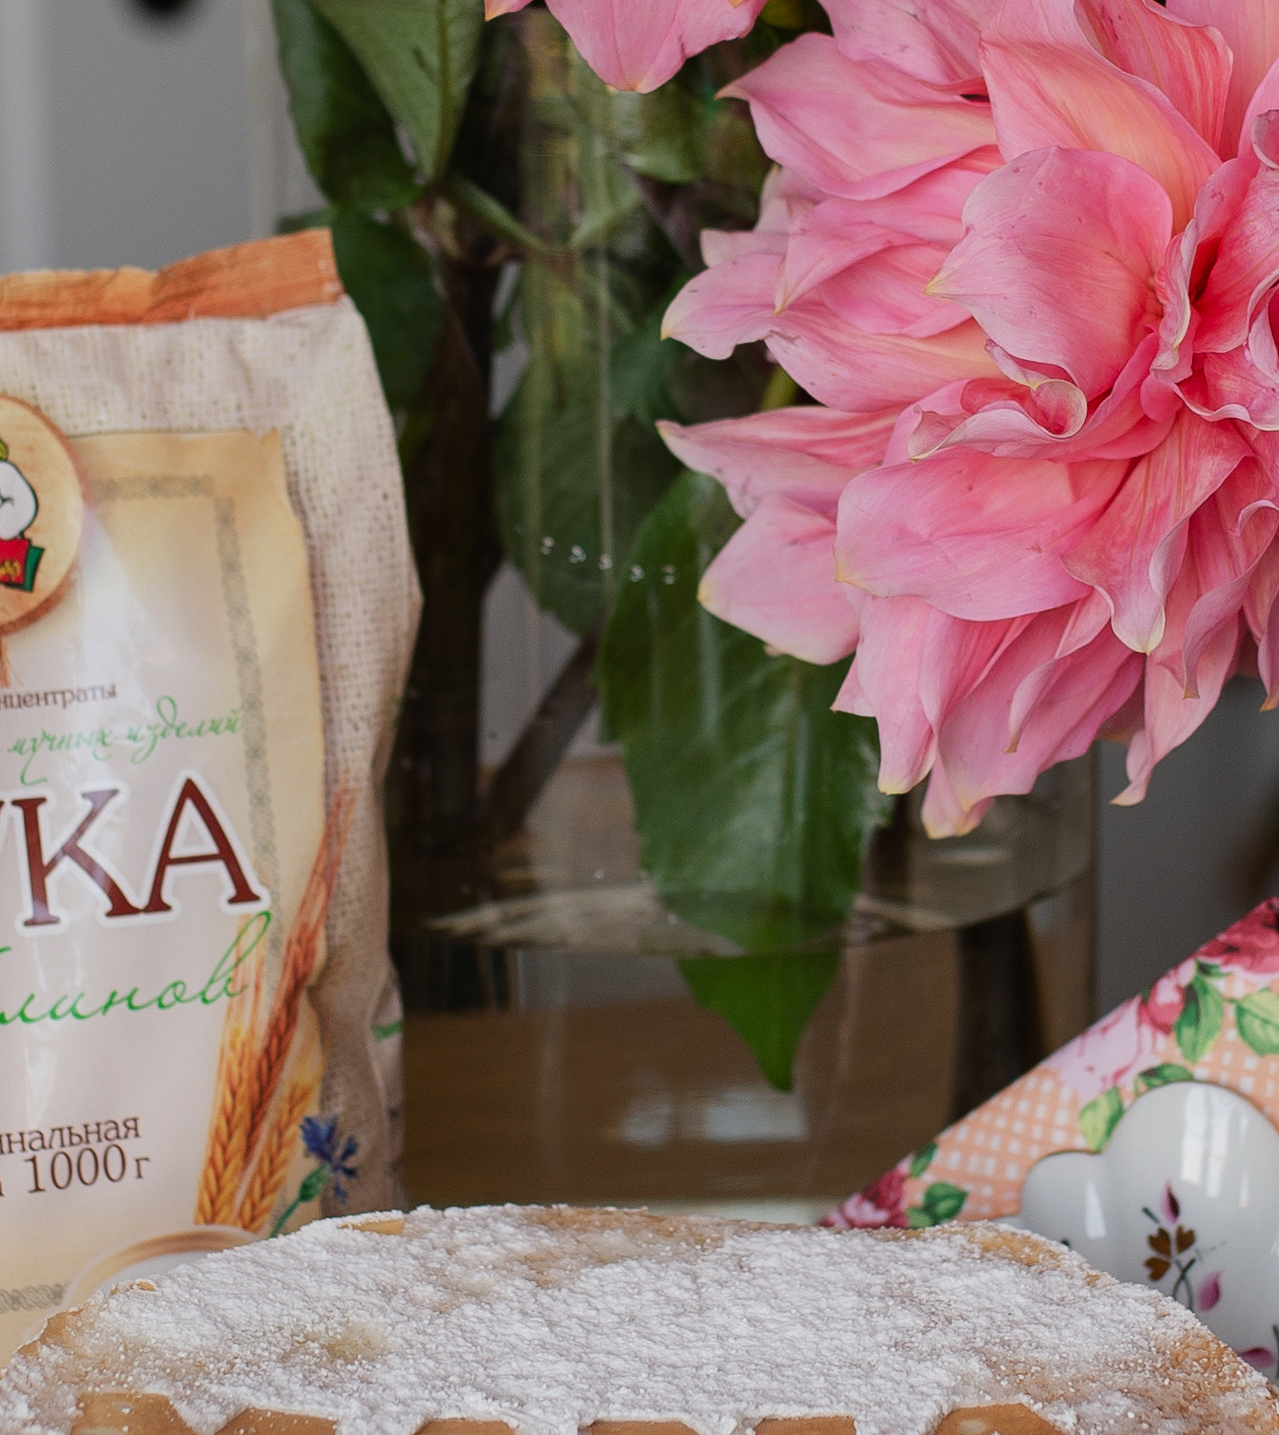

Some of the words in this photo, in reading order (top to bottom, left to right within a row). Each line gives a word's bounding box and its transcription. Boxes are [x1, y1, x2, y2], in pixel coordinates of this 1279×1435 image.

[8, 727, 119, 785] мучных
[122, 695, 243, 764] изделий
[23, 1143, 127, 1194] 1000
[133, 1156, 151, 1180] г
